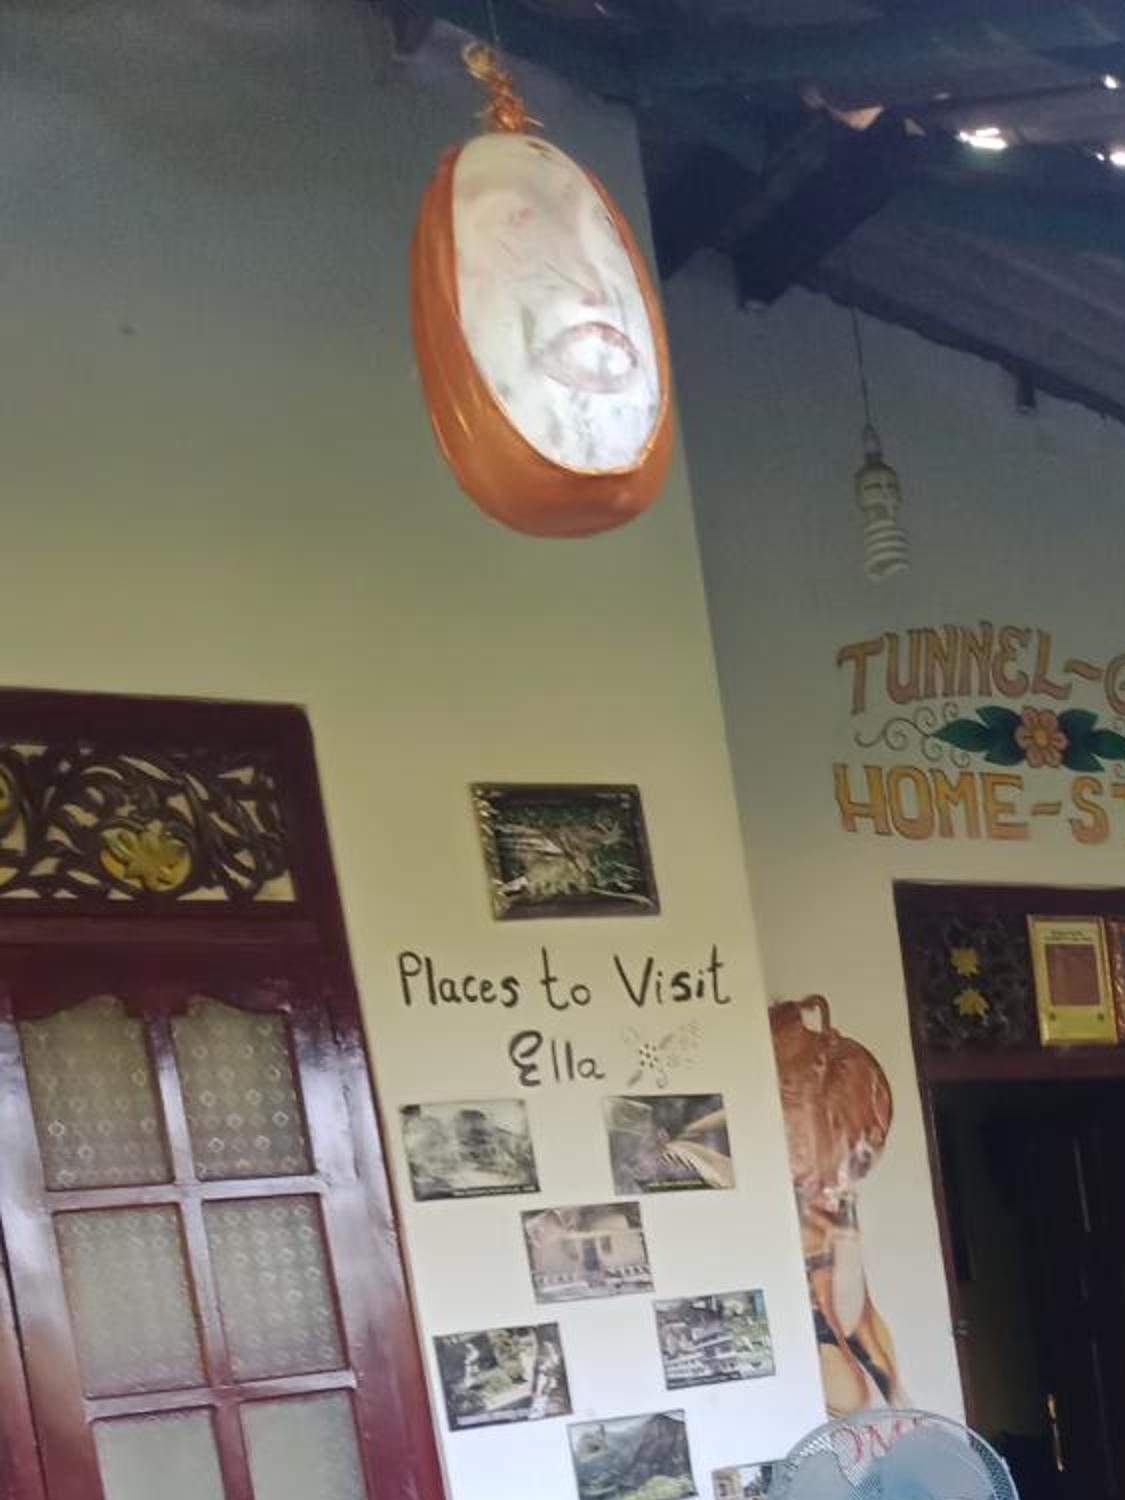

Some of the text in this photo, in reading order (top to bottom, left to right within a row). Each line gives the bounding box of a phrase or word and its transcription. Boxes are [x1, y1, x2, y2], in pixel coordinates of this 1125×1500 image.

[398, 944, 731, 1012] Places to Visit
[508, 1029, 606, 1088] Ella
